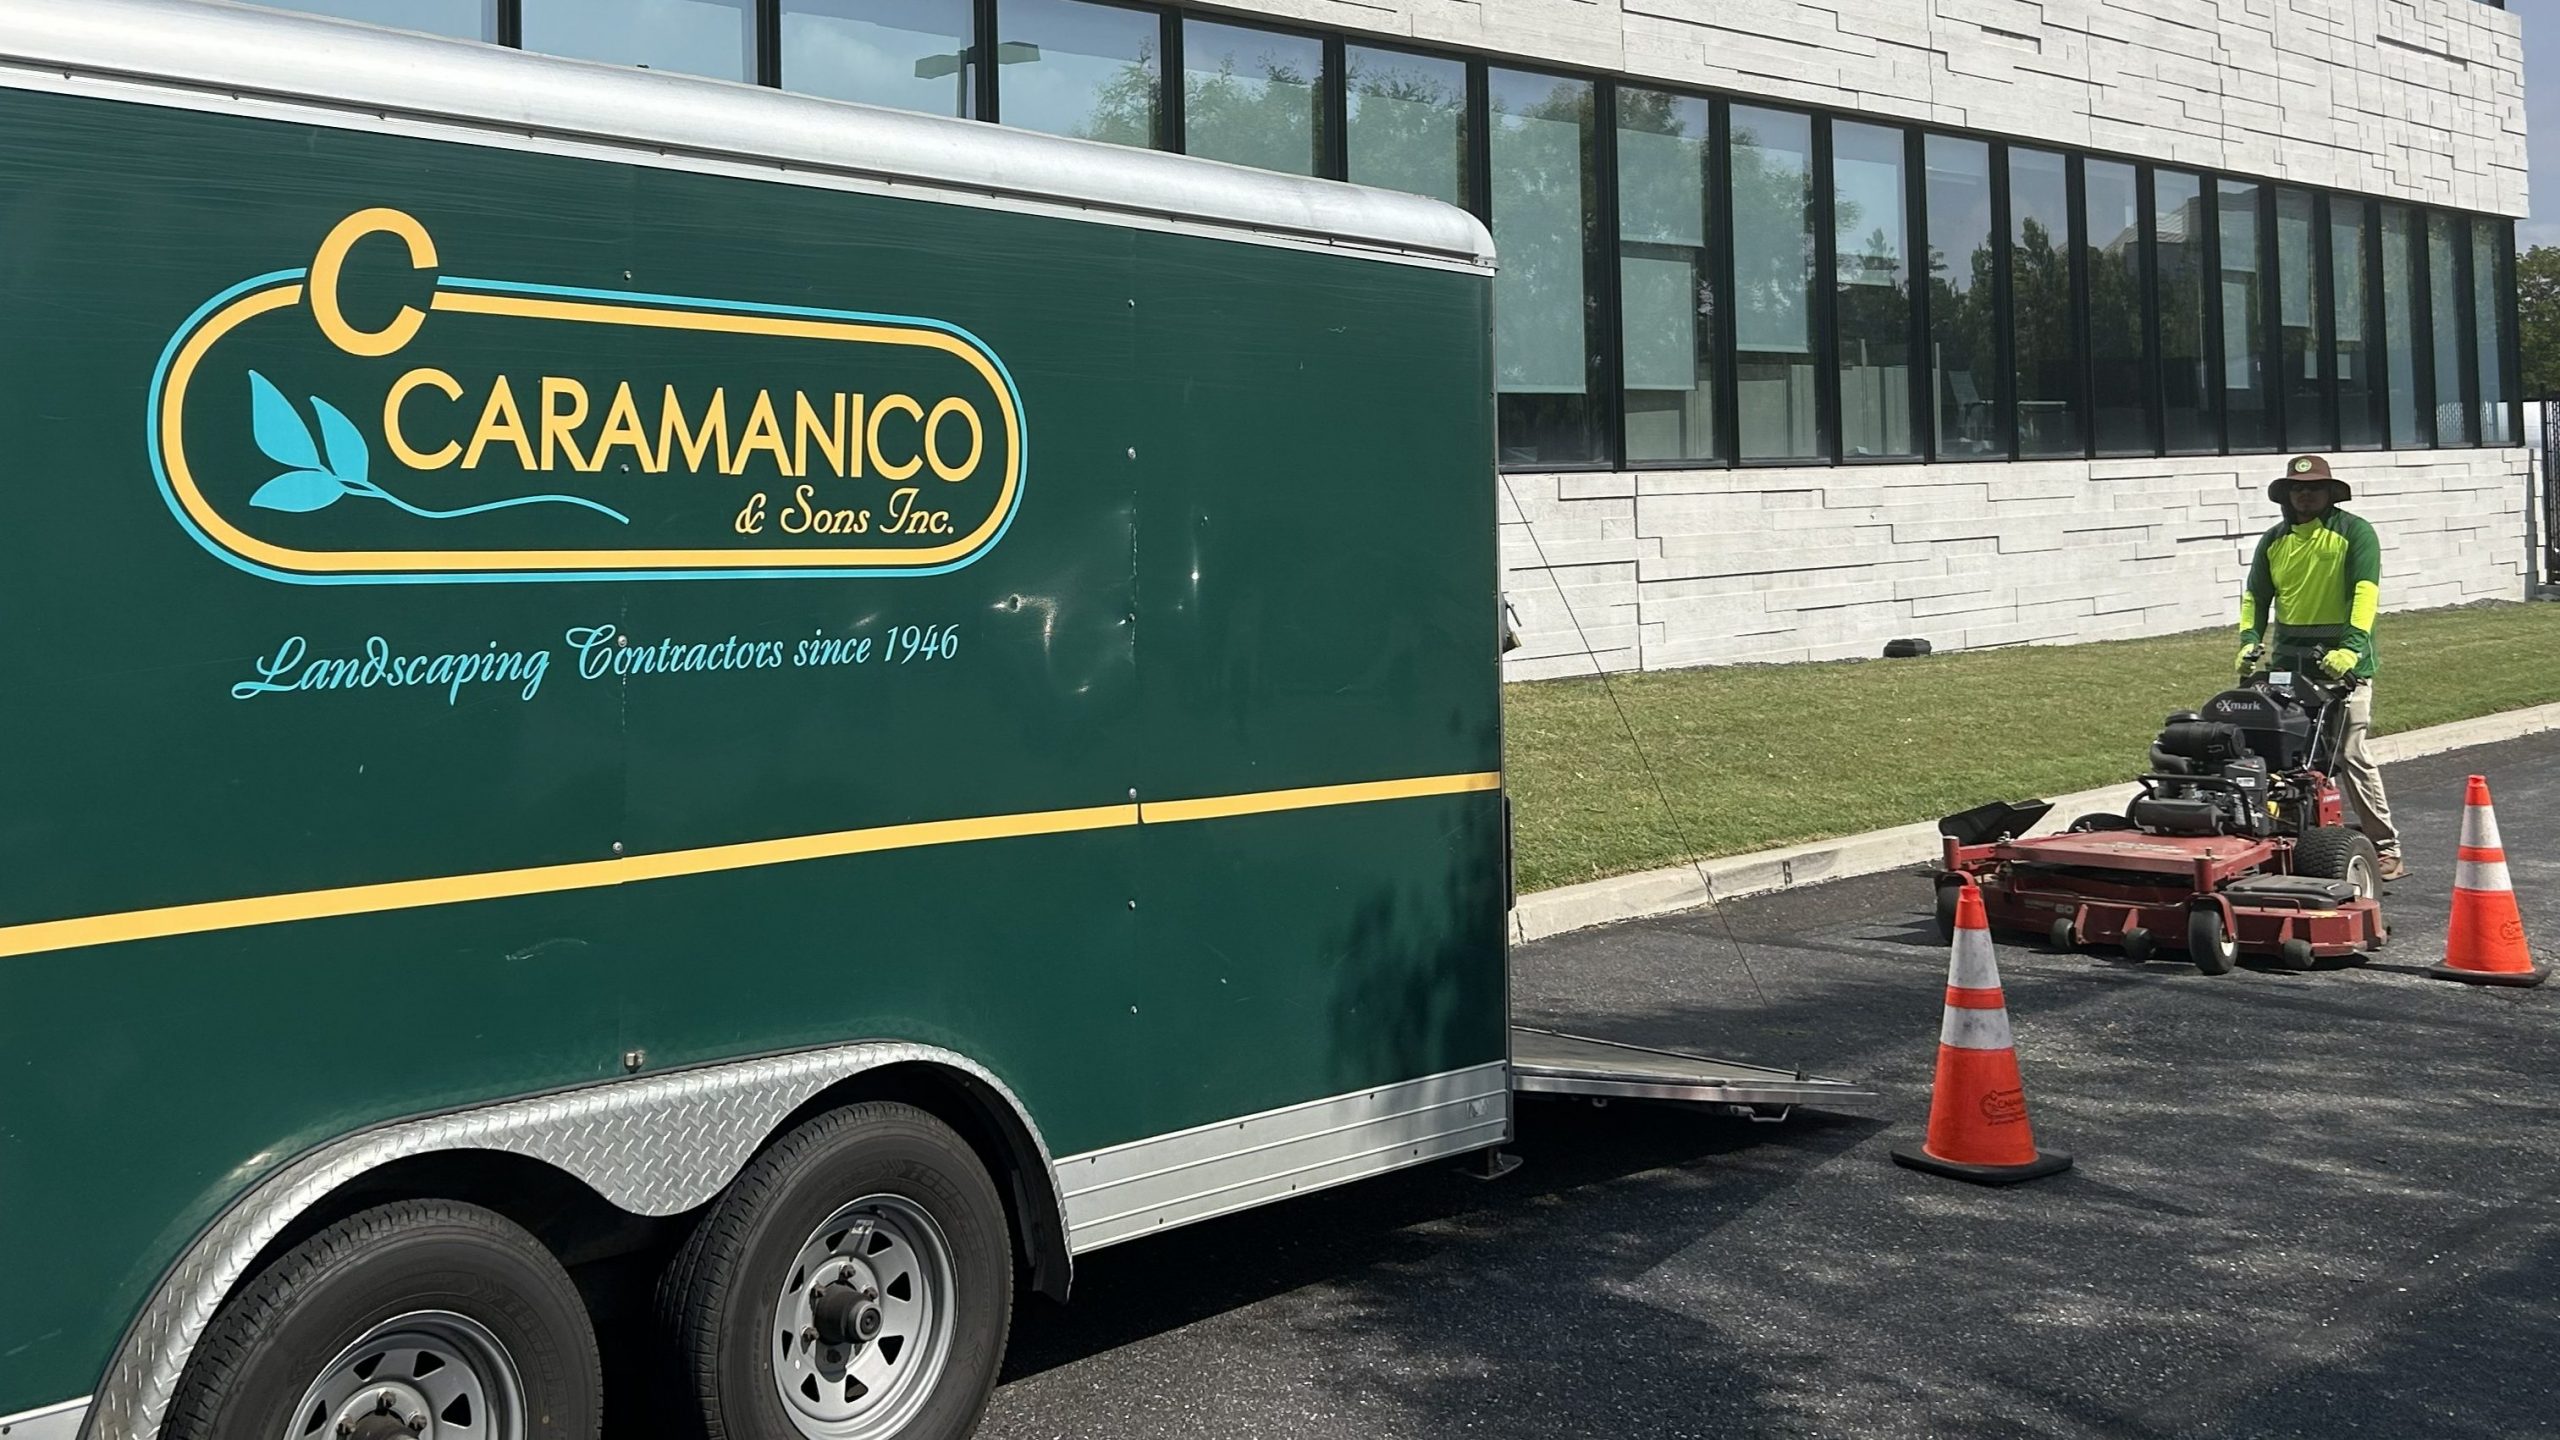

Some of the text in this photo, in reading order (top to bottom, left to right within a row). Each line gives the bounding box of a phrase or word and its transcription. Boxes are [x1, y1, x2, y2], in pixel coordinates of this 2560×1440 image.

[310, 207, 438, 357] C
[383, 367, 983, 483] CARAMANICO
[735, 484, 954, 534] & Sons Inc.
[231, 623, 960, 706] Landscaping Contractors since 1946
